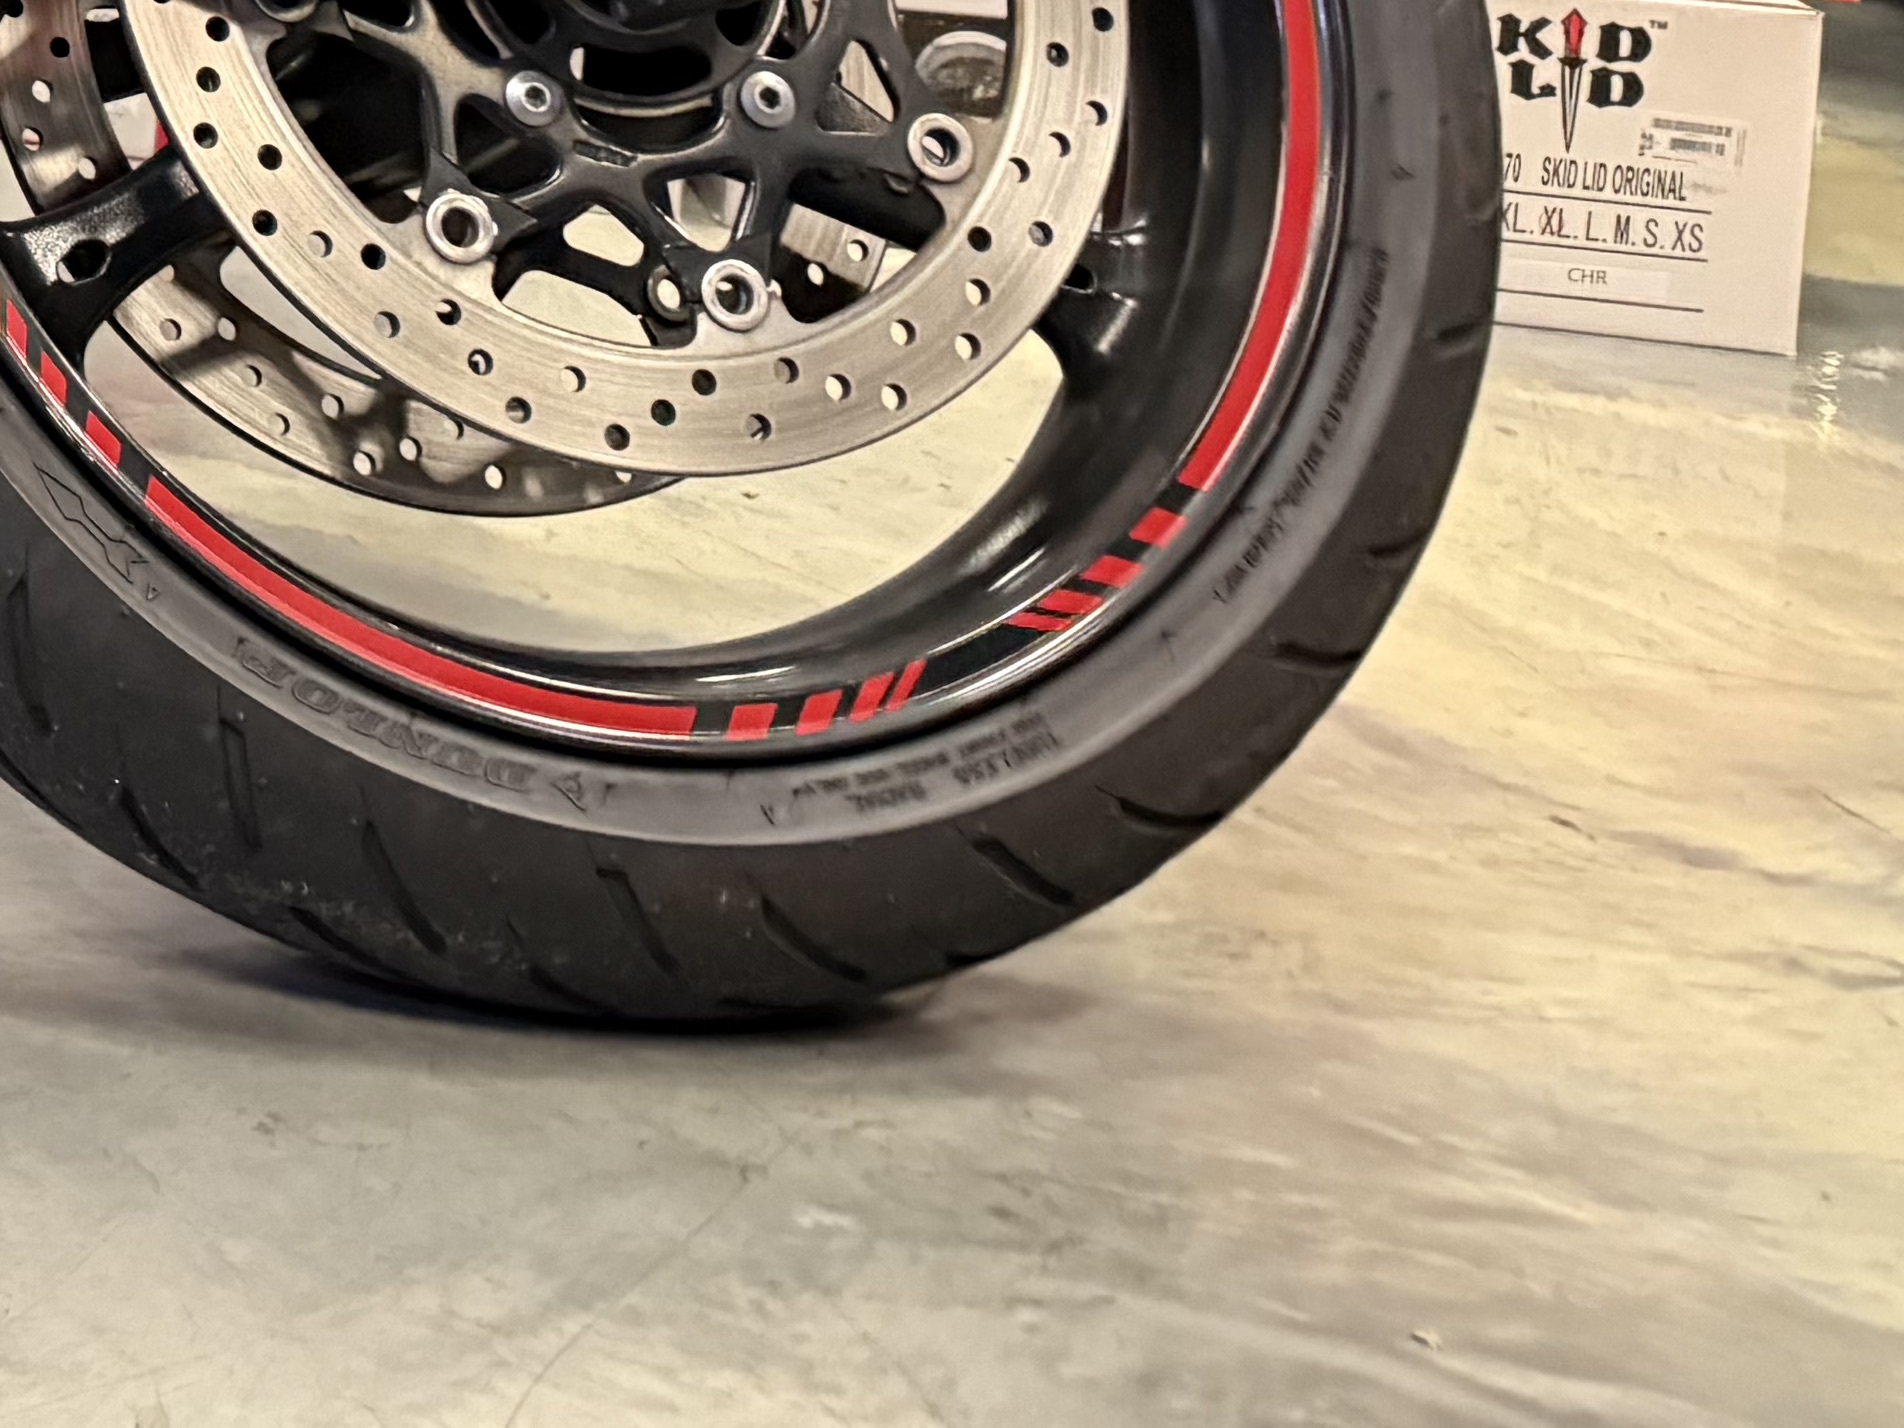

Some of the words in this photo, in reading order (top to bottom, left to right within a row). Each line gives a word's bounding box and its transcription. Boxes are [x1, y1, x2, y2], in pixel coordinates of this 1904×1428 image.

[1496, 8, 1653, 64] KID
[1541, 156, 1579, 189] SKID
[1582, 161, 1608, 192] LID
[1612, 164, 1688, 202] ORIGINAL
[1672, 220, 1705, 254] XS
[1567, 267, 1609, 286] CHR
